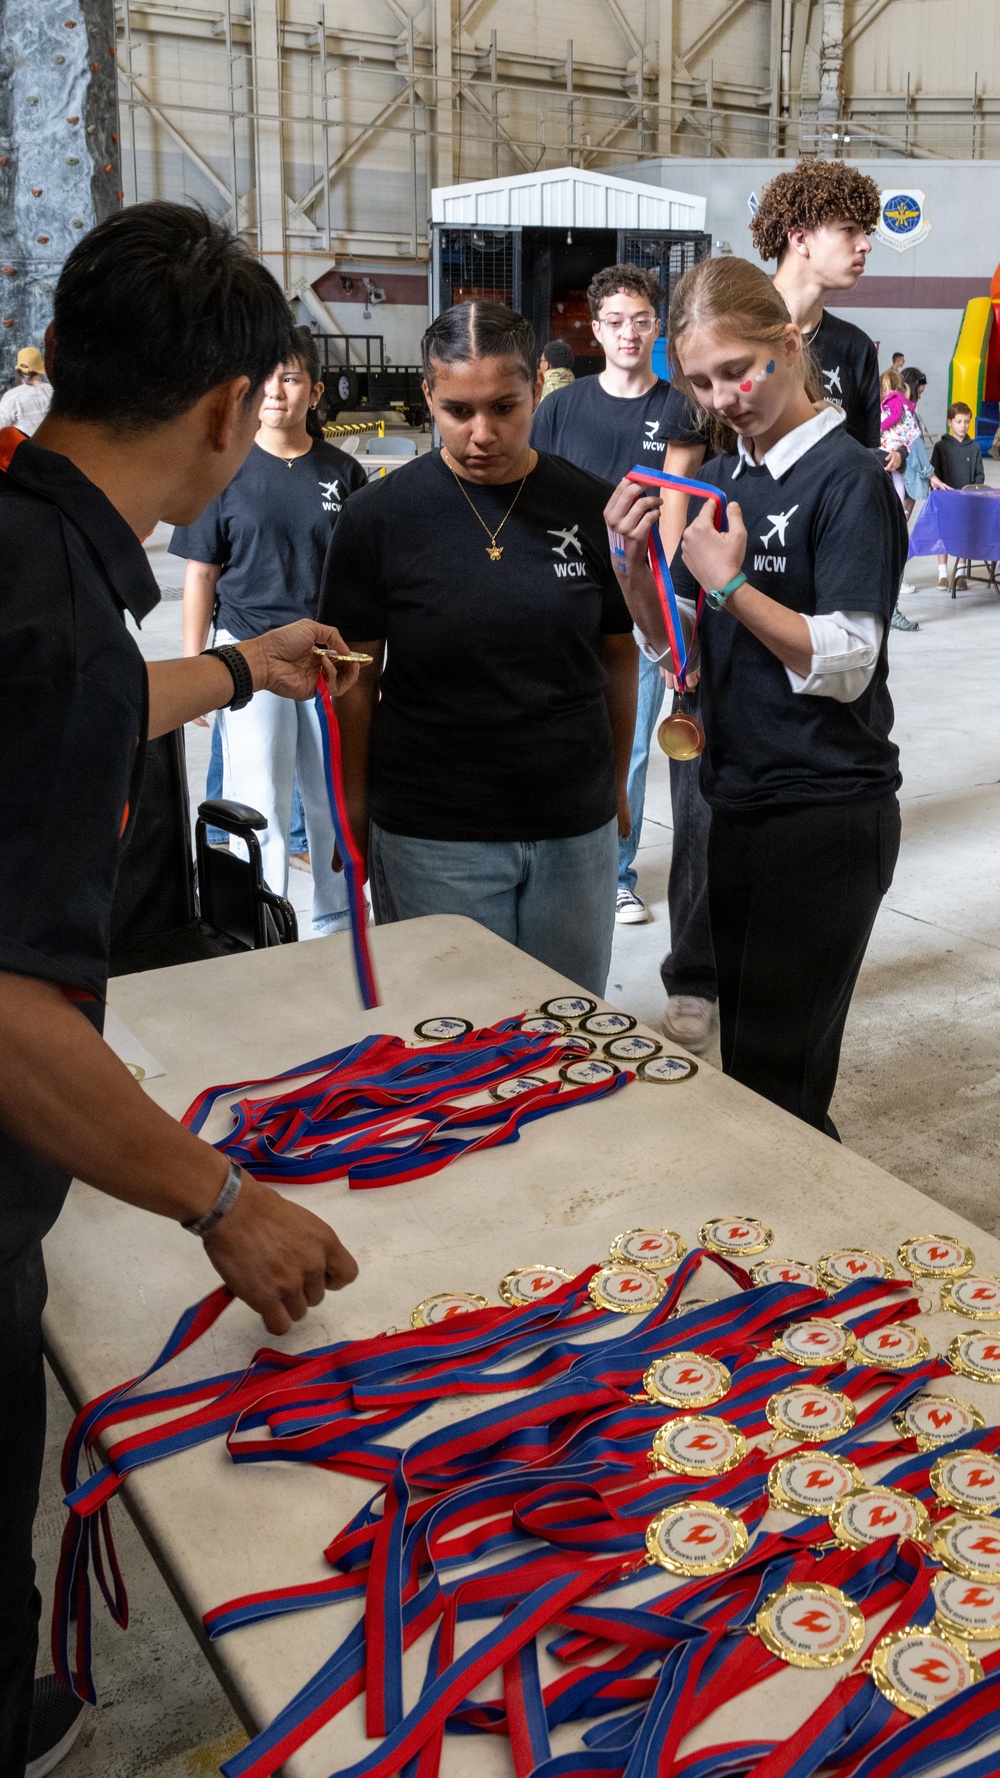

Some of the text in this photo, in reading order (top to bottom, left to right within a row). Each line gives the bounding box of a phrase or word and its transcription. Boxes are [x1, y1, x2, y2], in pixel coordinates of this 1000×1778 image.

[642, 440, 665, 452] WCW
[322, 502, 342, 512] WCW
[554, 562, 586, 578] WCW
[754, 554, 786, 573] WCW
